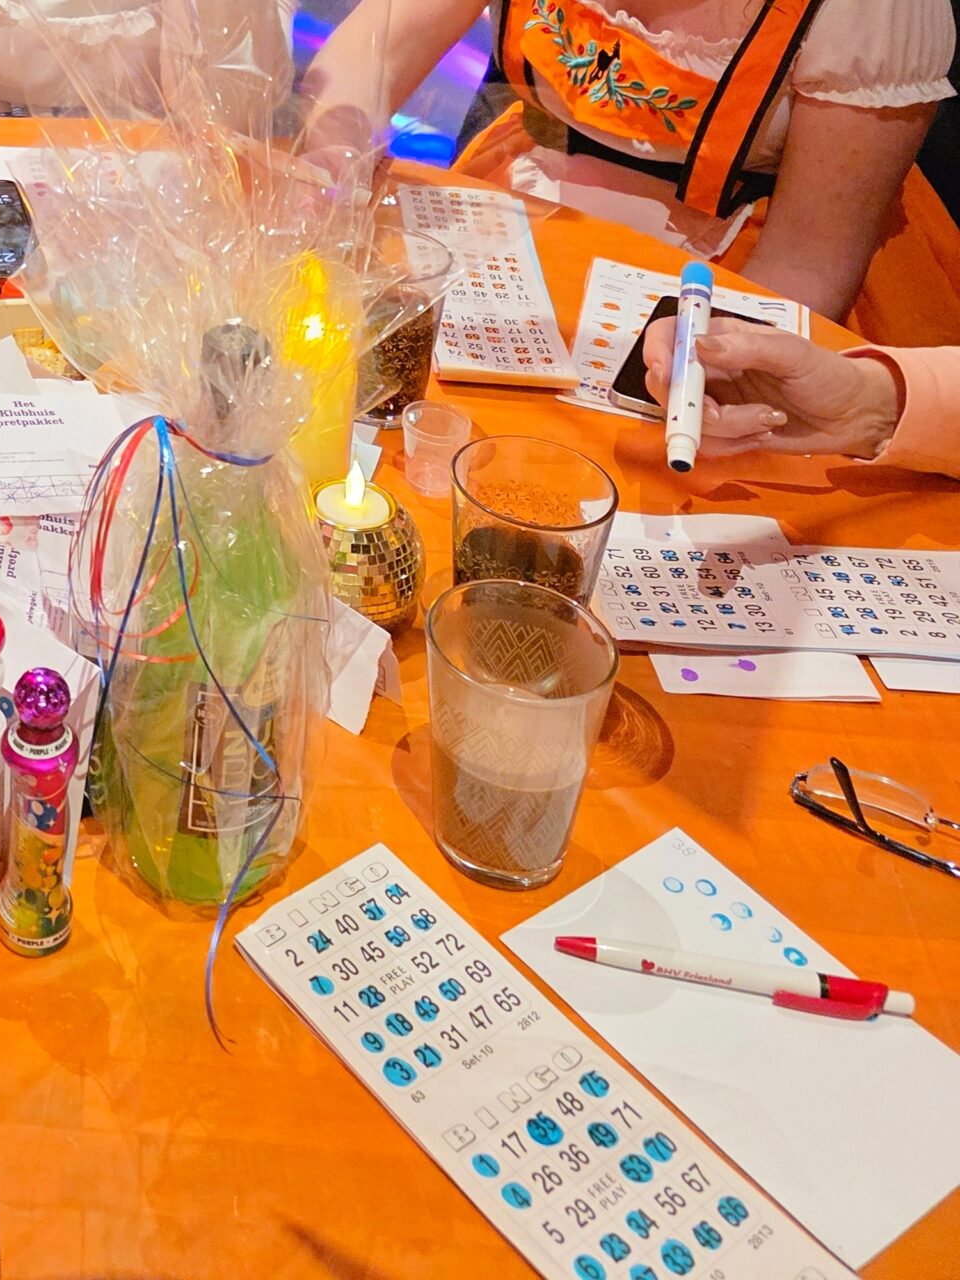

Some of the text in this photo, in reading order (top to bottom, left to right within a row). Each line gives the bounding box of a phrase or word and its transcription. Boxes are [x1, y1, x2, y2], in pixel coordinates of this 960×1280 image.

[616, 565, 633, 578] 52
[633, 549, 671, 597] 31 69
[844, 589, 866, 602] 32
[875, 557, 897, 568] 72
[900, 559, 924, 605] 38 65
[697, 619, 718, 631] 12
[744, 604, 776, 633] 13 30
[884, 608, 906, 620] 19
[255, 861, 389, 948] BINGO
[285, 883, 411, 967] 2 24 40 57 64
[308, 908, 437, 994] 7 30 45 59 68
[333, 933, 466, 1023] 11 28 FREE 52 72
[363, 959, 492, 1052] 9 18 43 50 69
[389, 976, 416, 996] PLAY
[410, 1010, 542, 1104] 63 Set-10 2812
[414, 987, 521, 1068] 21 31 47 65
[441, 1045, 584, 1153] BINGO
[501, 1070, 610, 1159] 17 35 48 75
[511, 1100, 643, 1207] 4 26 36 49 71
[542, 1131, 678, 1244] 5 29 FREE 53 70
[598, 1186, 628, 1211] PLAY
[600, 1162, 711, 1263] 23 34 56 67
[692, 1198, 749, 1249] 46 66
[748, 1224, 774, 1250] 2813
